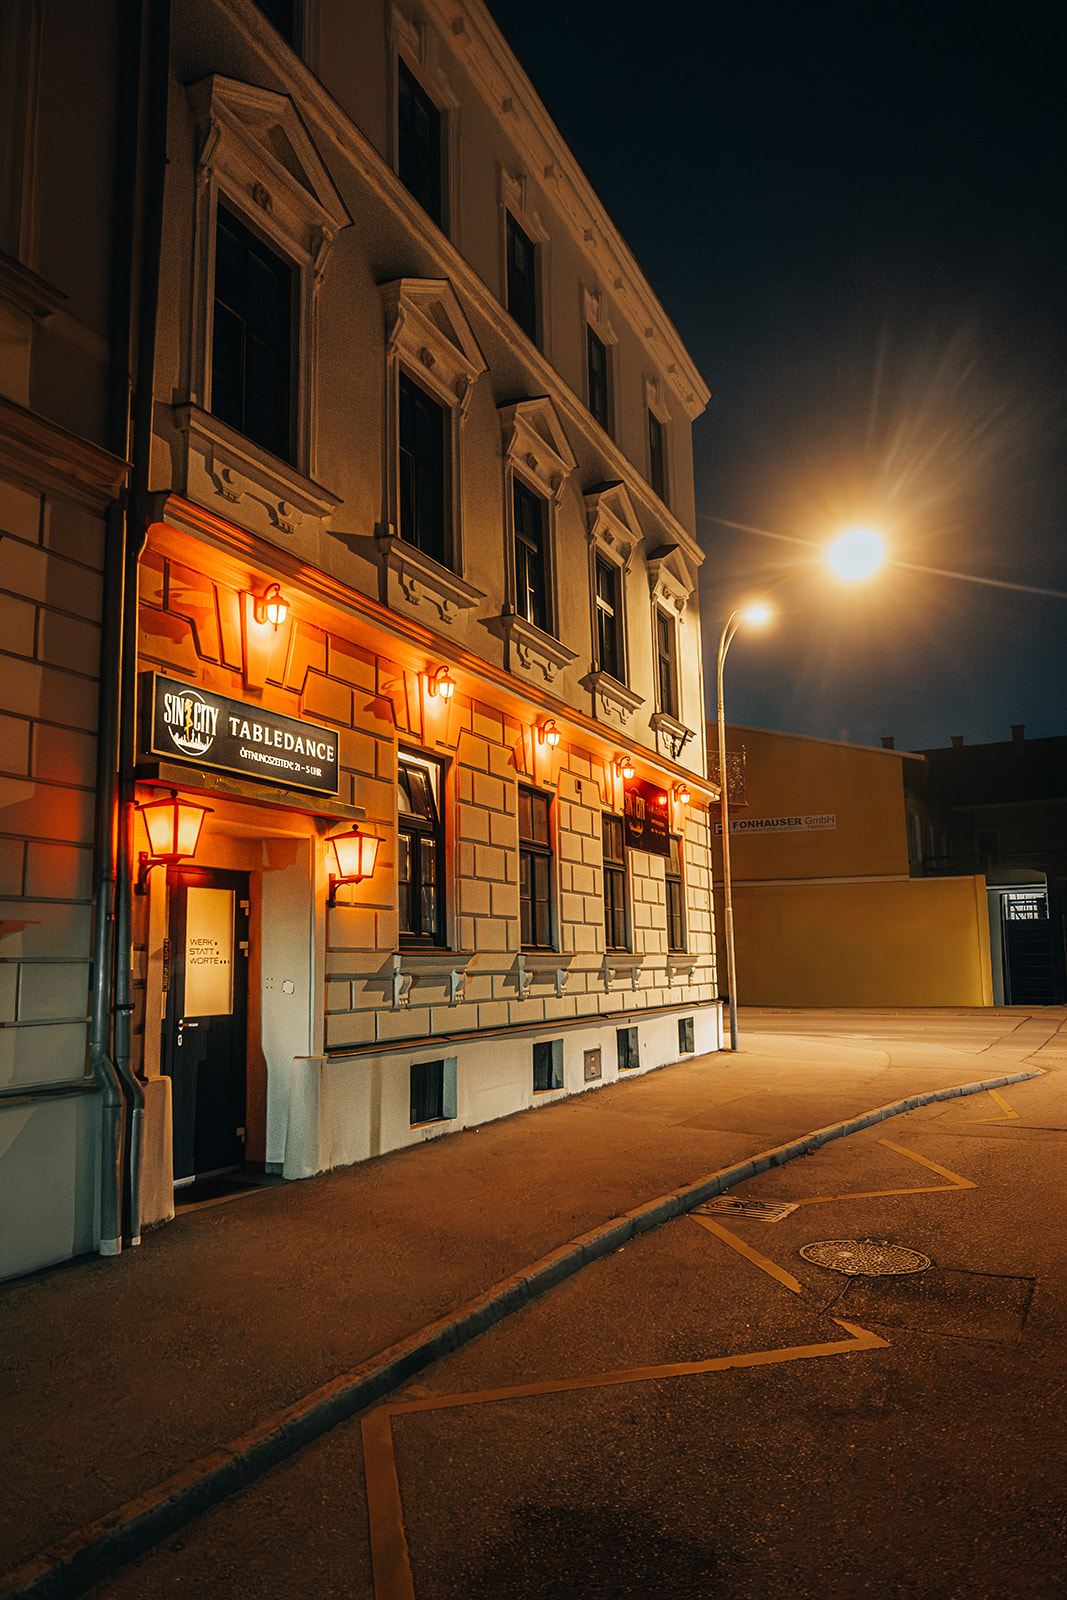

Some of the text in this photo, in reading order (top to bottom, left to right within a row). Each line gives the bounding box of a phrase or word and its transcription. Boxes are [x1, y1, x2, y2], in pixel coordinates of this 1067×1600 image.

[163, 692, 219, 736] SIN CITY
[229, 717, 335, 762] TABLEDANCE
[305, 765, 310, 774] 5
[310, 766, 323, 777] UHR
[733, 818, 802, 829] FONHAUSER
[805, 815, 835, 825] GmbH
